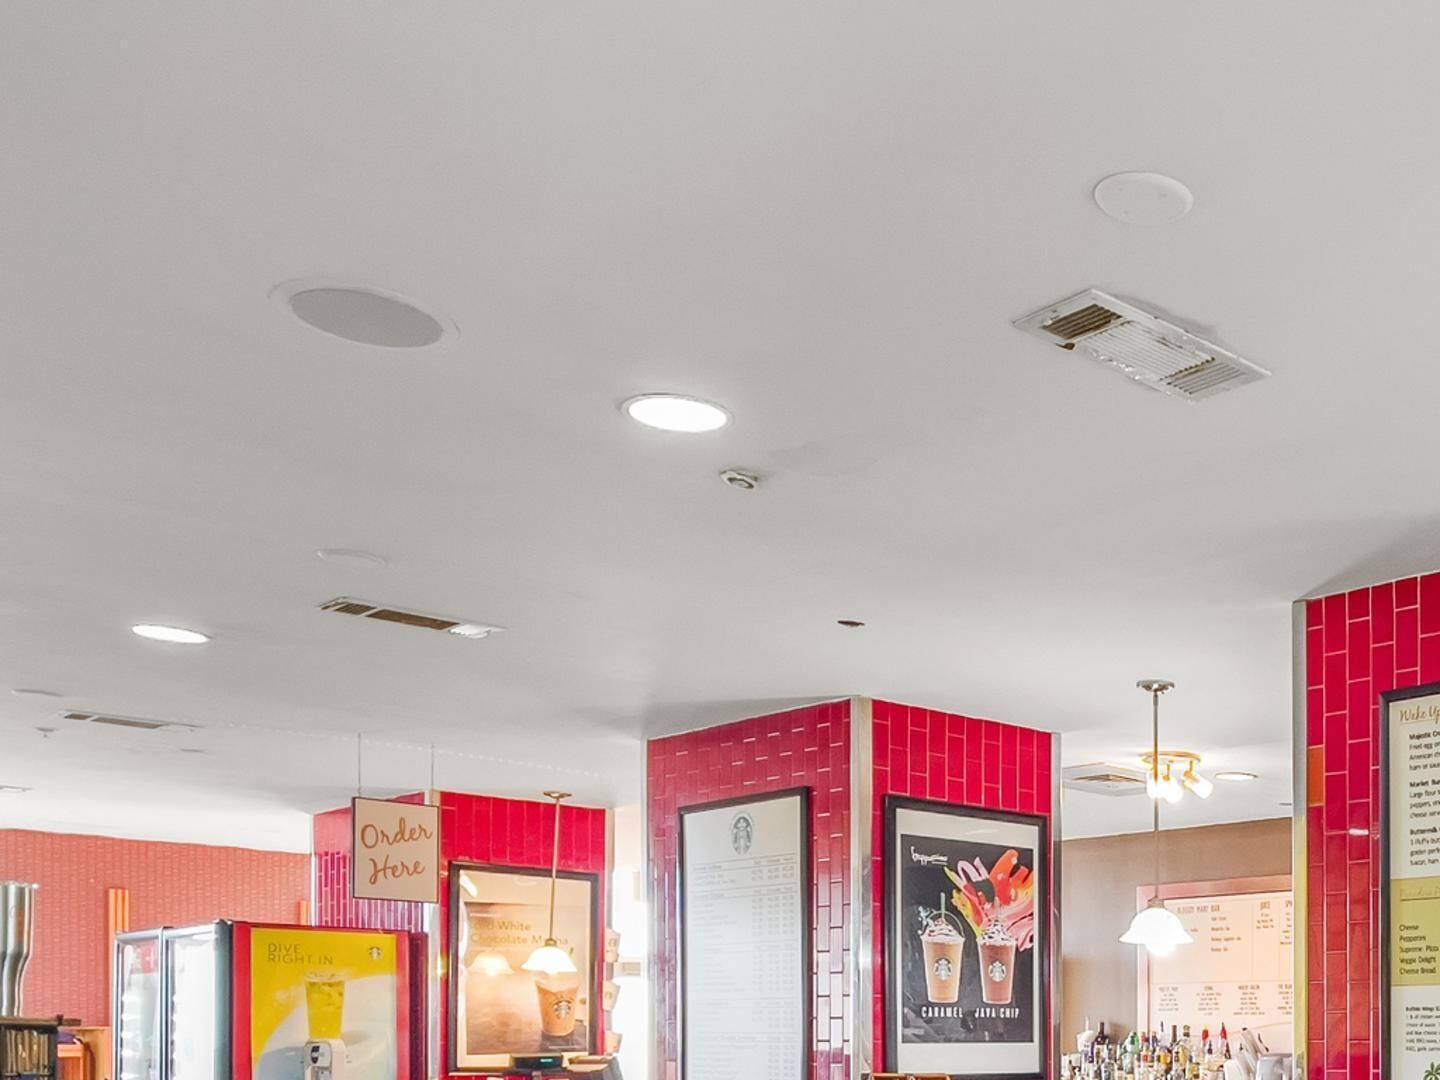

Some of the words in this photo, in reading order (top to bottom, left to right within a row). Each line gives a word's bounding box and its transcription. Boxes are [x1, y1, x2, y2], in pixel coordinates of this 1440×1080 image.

[361, 817, 433, 848] Order
[369, 854, 425, 885] Here
[497, 921, 531, 931] White
[268, 943, 301, 953] DIVE
[267, 954, 312, 964] RIGHT
[319, 956, 333, 965] IN
[921, 1006, 963, 1018] CARAMEL
[975, 1007, 996, 1018] JAVA
[1000, 1008, 1020, 1018] CHIP
